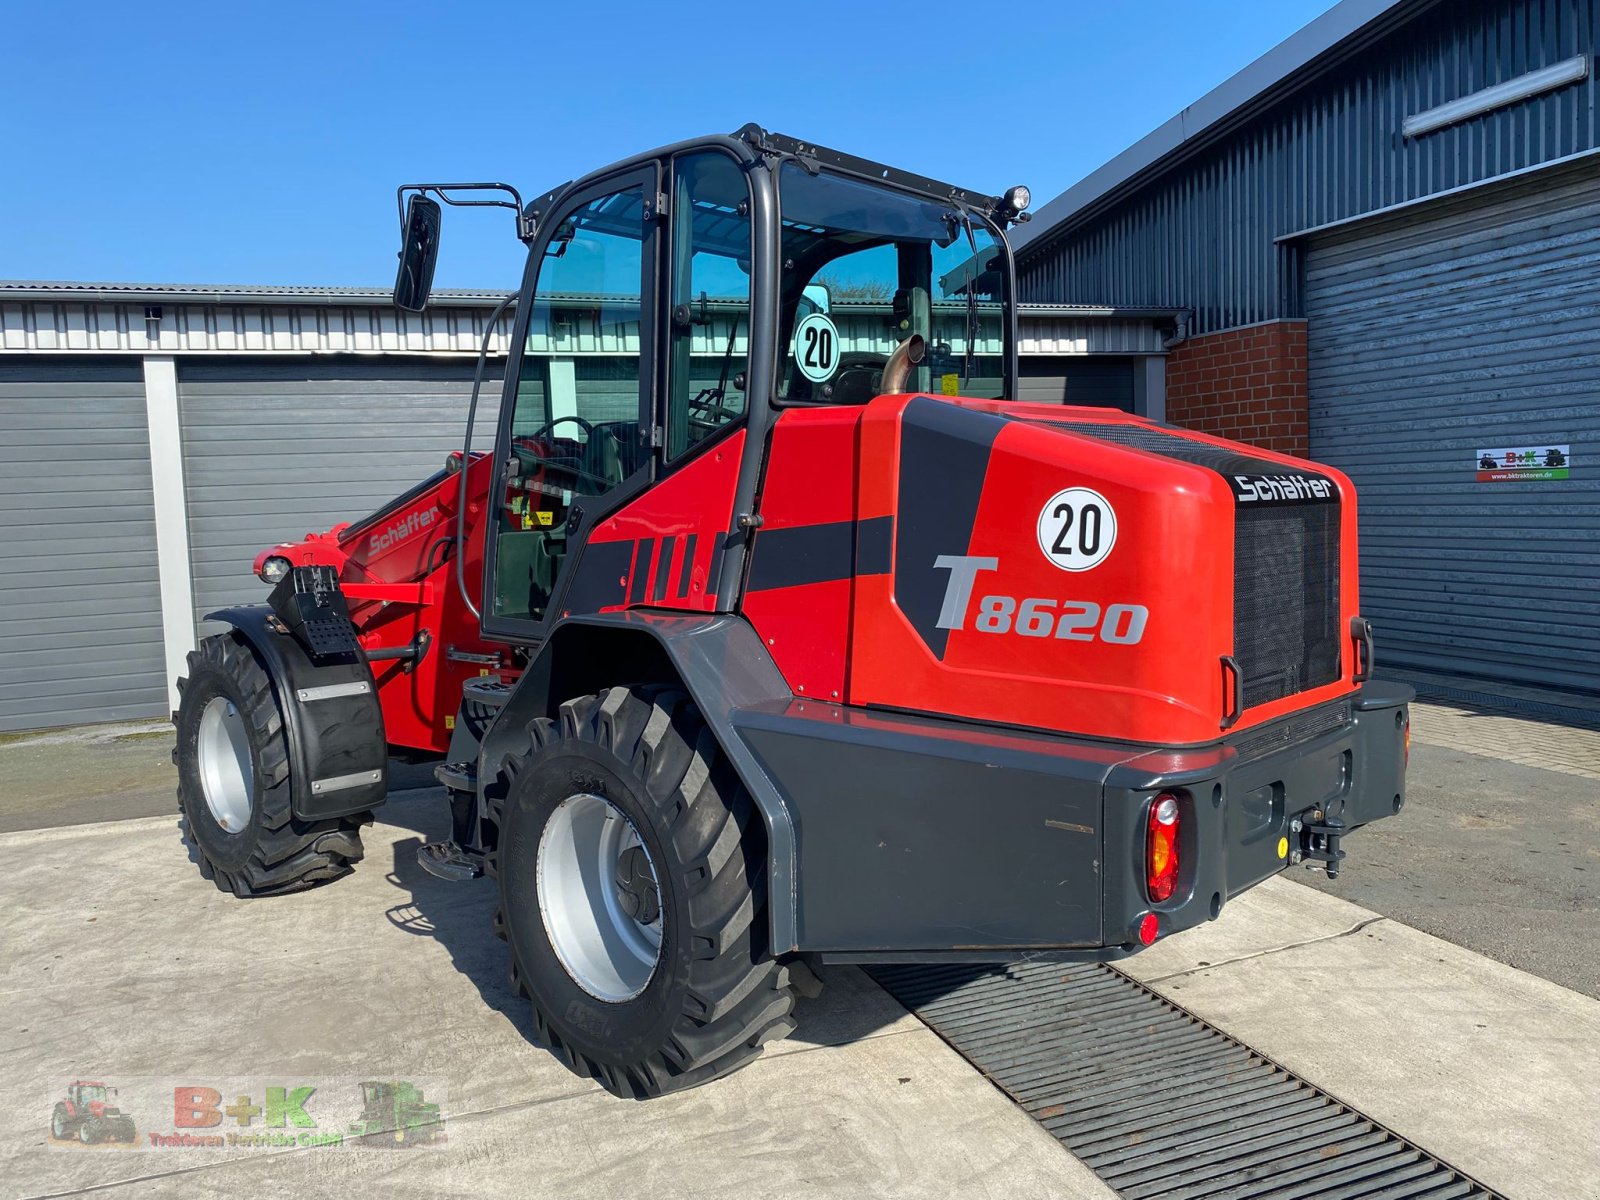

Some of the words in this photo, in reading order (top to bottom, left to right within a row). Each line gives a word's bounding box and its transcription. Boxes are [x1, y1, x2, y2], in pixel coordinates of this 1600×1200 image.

[805, 326, 832, 369] 20
[1506, 451, 1537, 463] B+K
[1234, 475, 1332, 502] Schäffer
[1491, 472, 1553, 480] www.bktraktoren.de
[367, 506, 439, 557] Schäffer
[1051, 503, 1101, 557] 20
